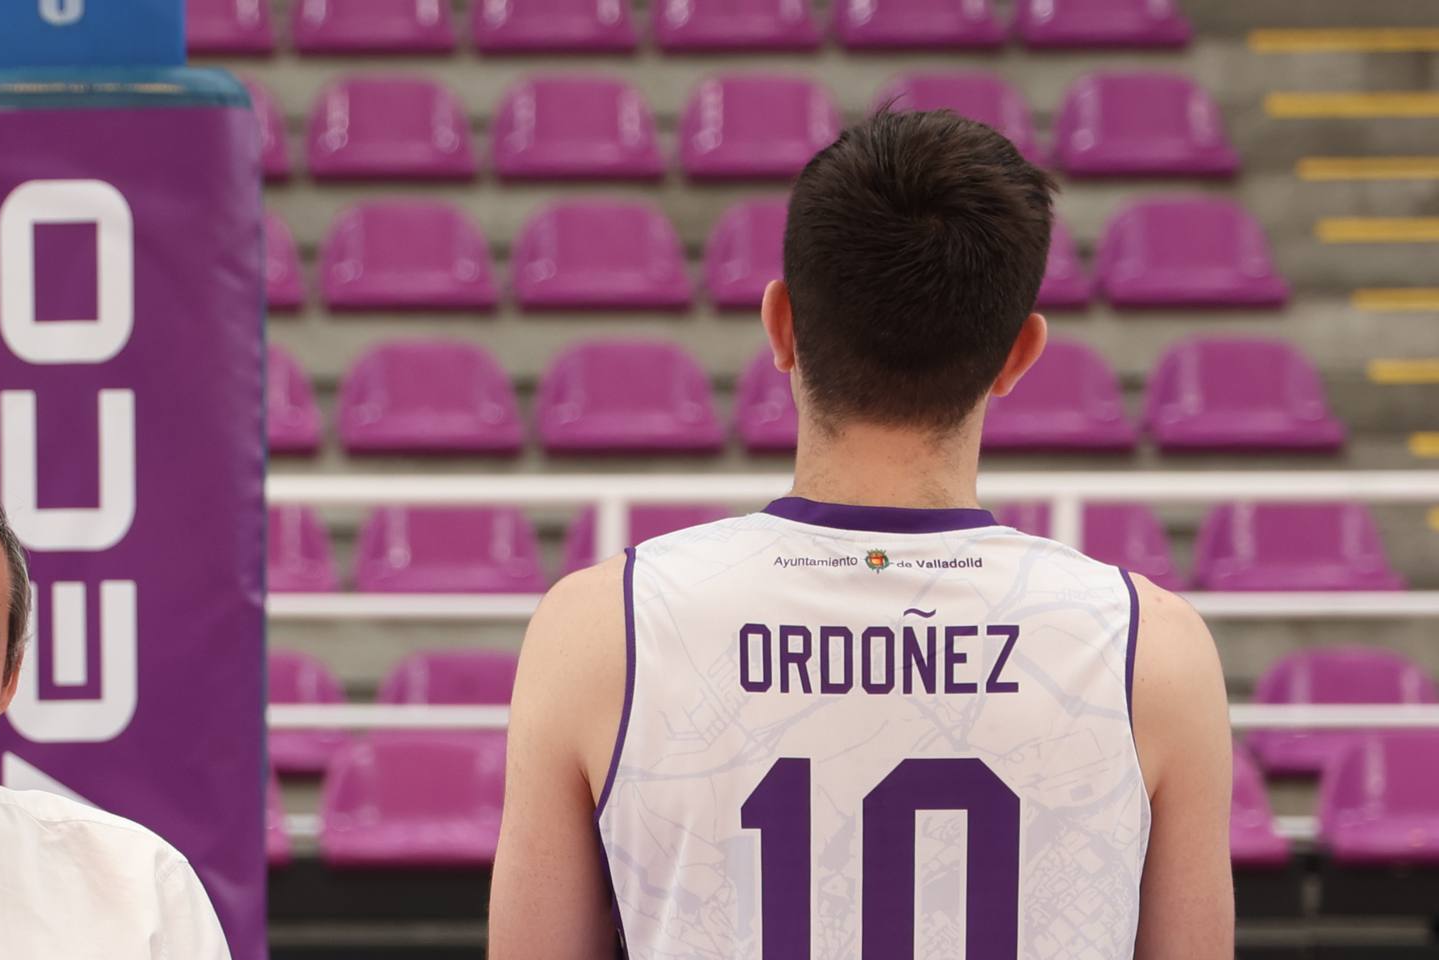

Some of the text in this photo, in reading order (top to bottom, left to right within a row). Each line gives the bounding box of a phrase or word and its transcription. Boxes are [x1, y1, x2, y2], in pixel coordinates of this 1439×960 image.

[773, 555, 858, 568] Ayuntamiento
[916, 557, 983, 569] Valladolid
[739, 608, 1020, 695] ORDOÑEZ
